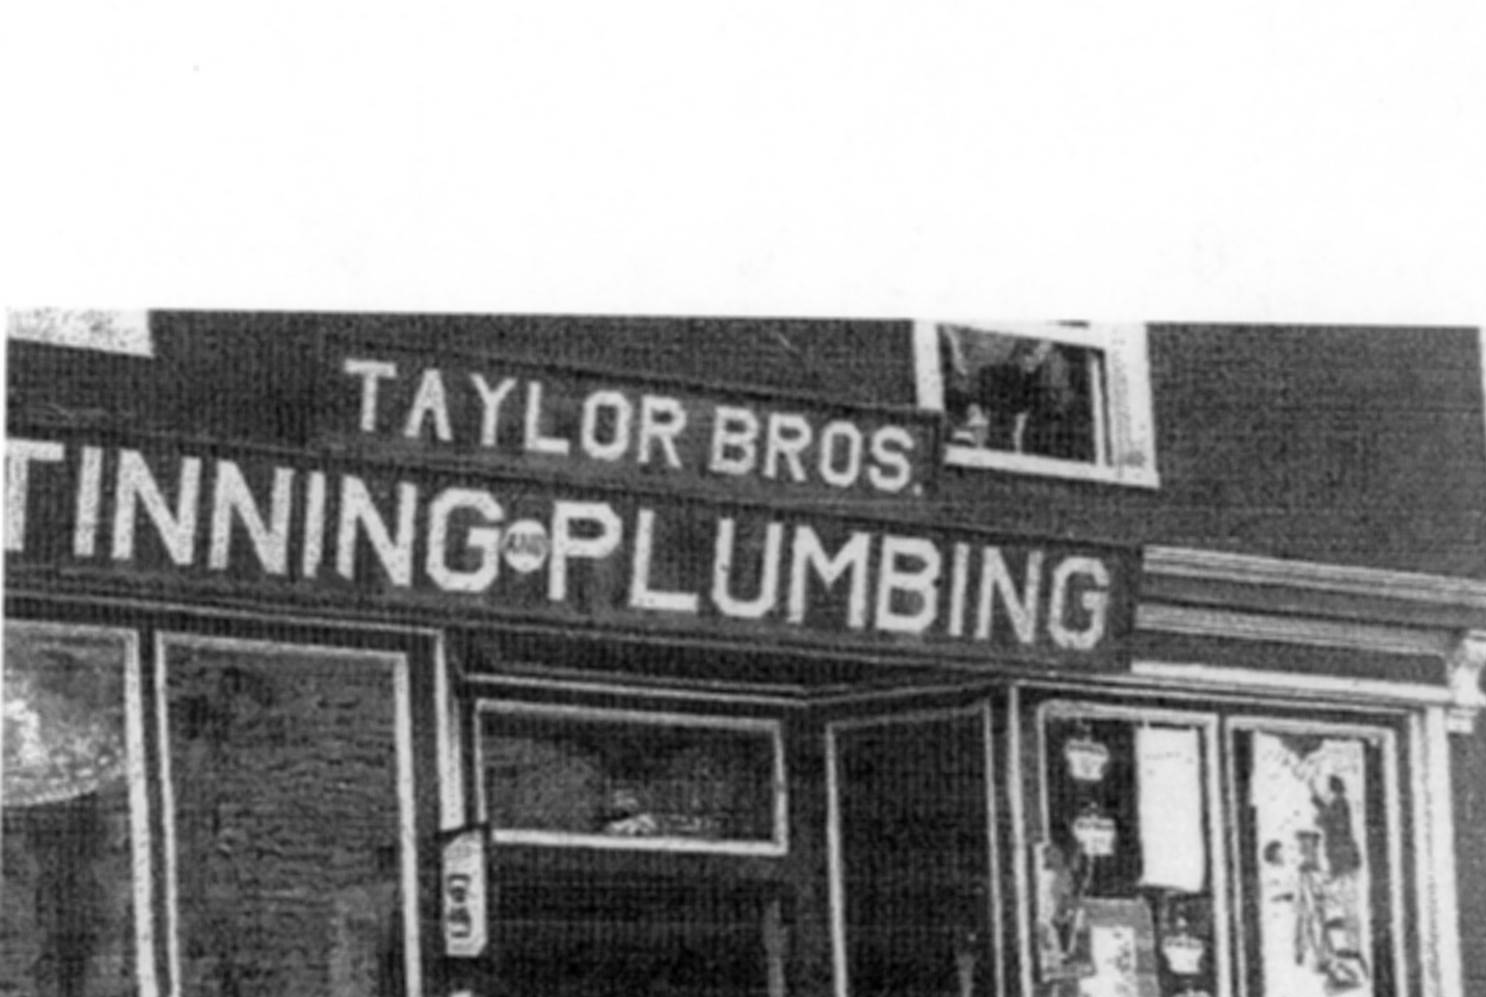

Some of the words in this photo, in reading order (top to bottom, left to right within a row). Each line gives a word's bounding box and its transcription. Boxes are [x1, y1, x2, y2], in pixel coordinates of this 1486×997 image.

[343, 357, 688, 468] TAYLOR
[708, 404, 924, 496] BROS.
[4, 437, 503, 592] TINNING
[548, 500, 1110, 650] PLUMBING
